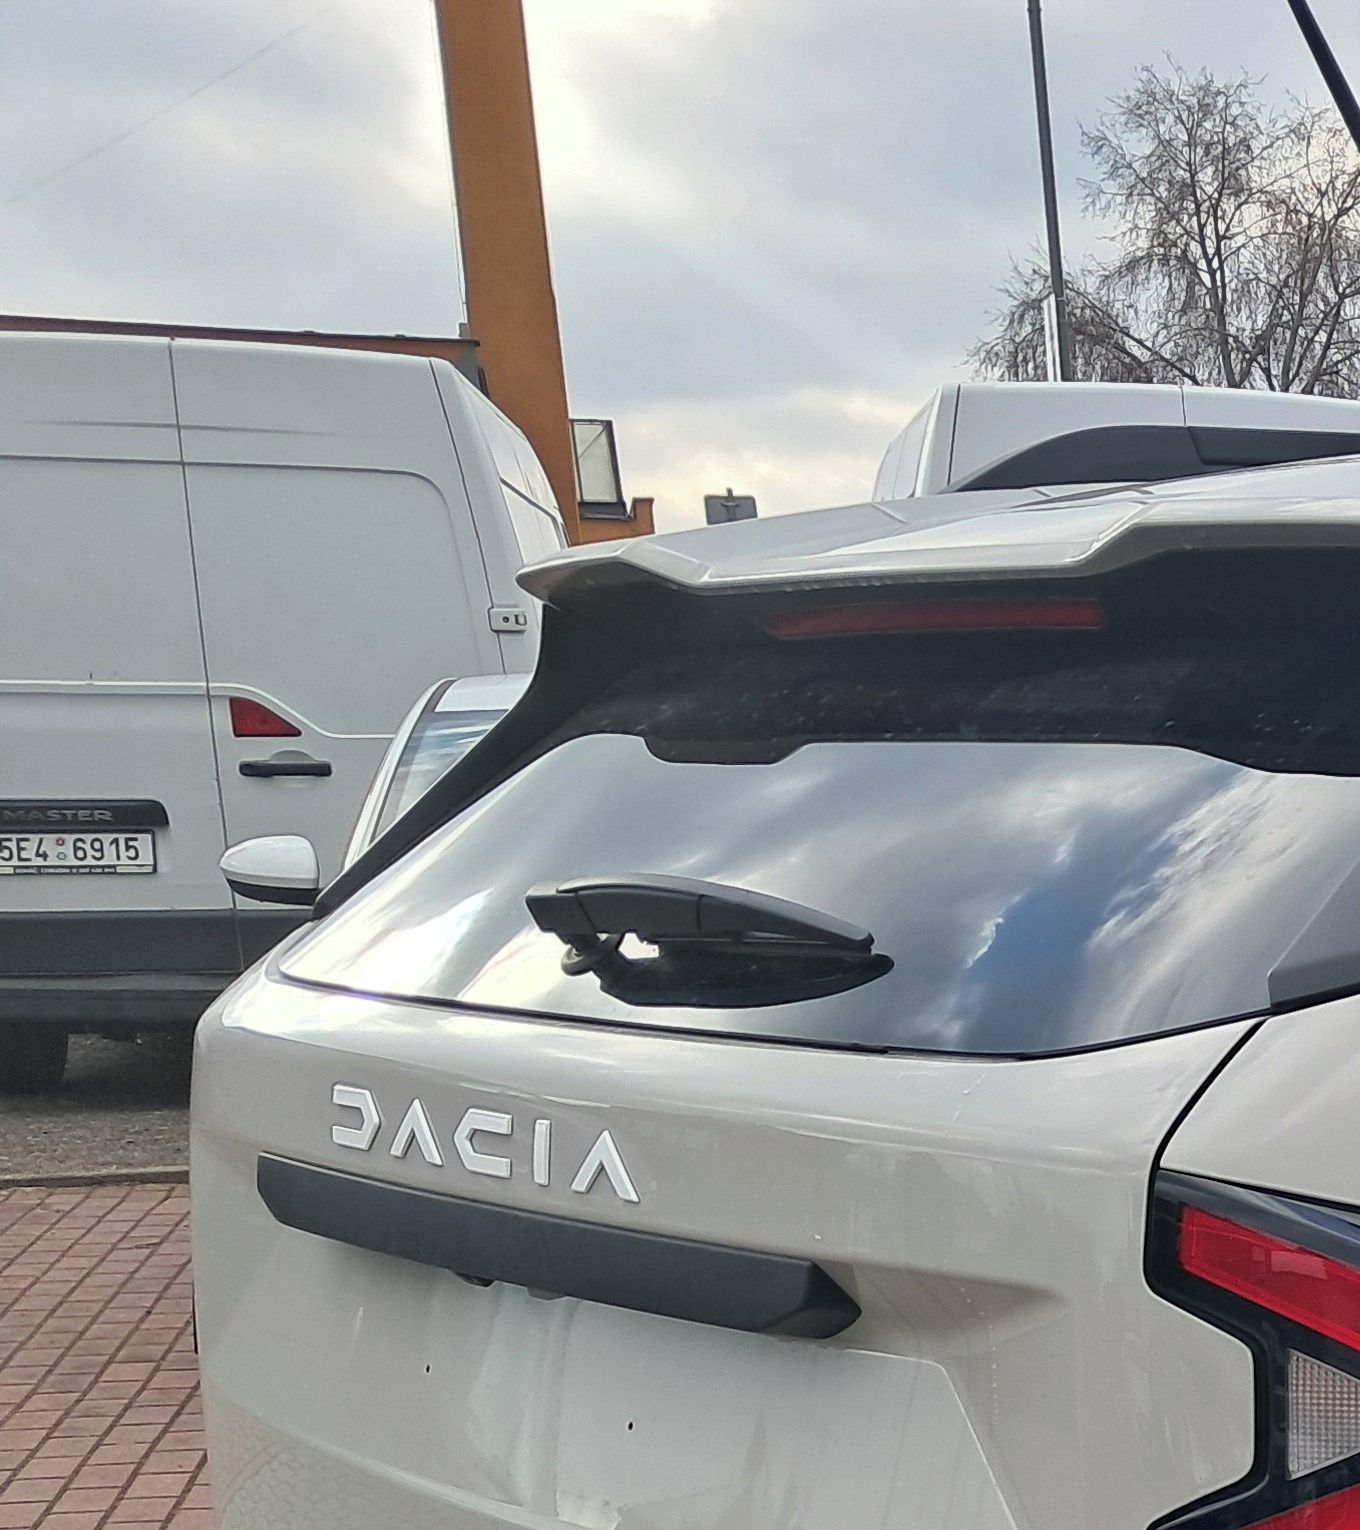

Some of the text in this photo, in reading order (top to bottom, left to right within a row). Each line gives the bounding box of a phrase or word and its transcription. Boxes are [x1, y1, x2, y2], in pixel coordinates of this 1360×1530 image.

[2, 809, 114, 821] MASTER
[0, 837, 140, 862] 5E4 6915
[330, 1082, 640, 1203] DACIA
